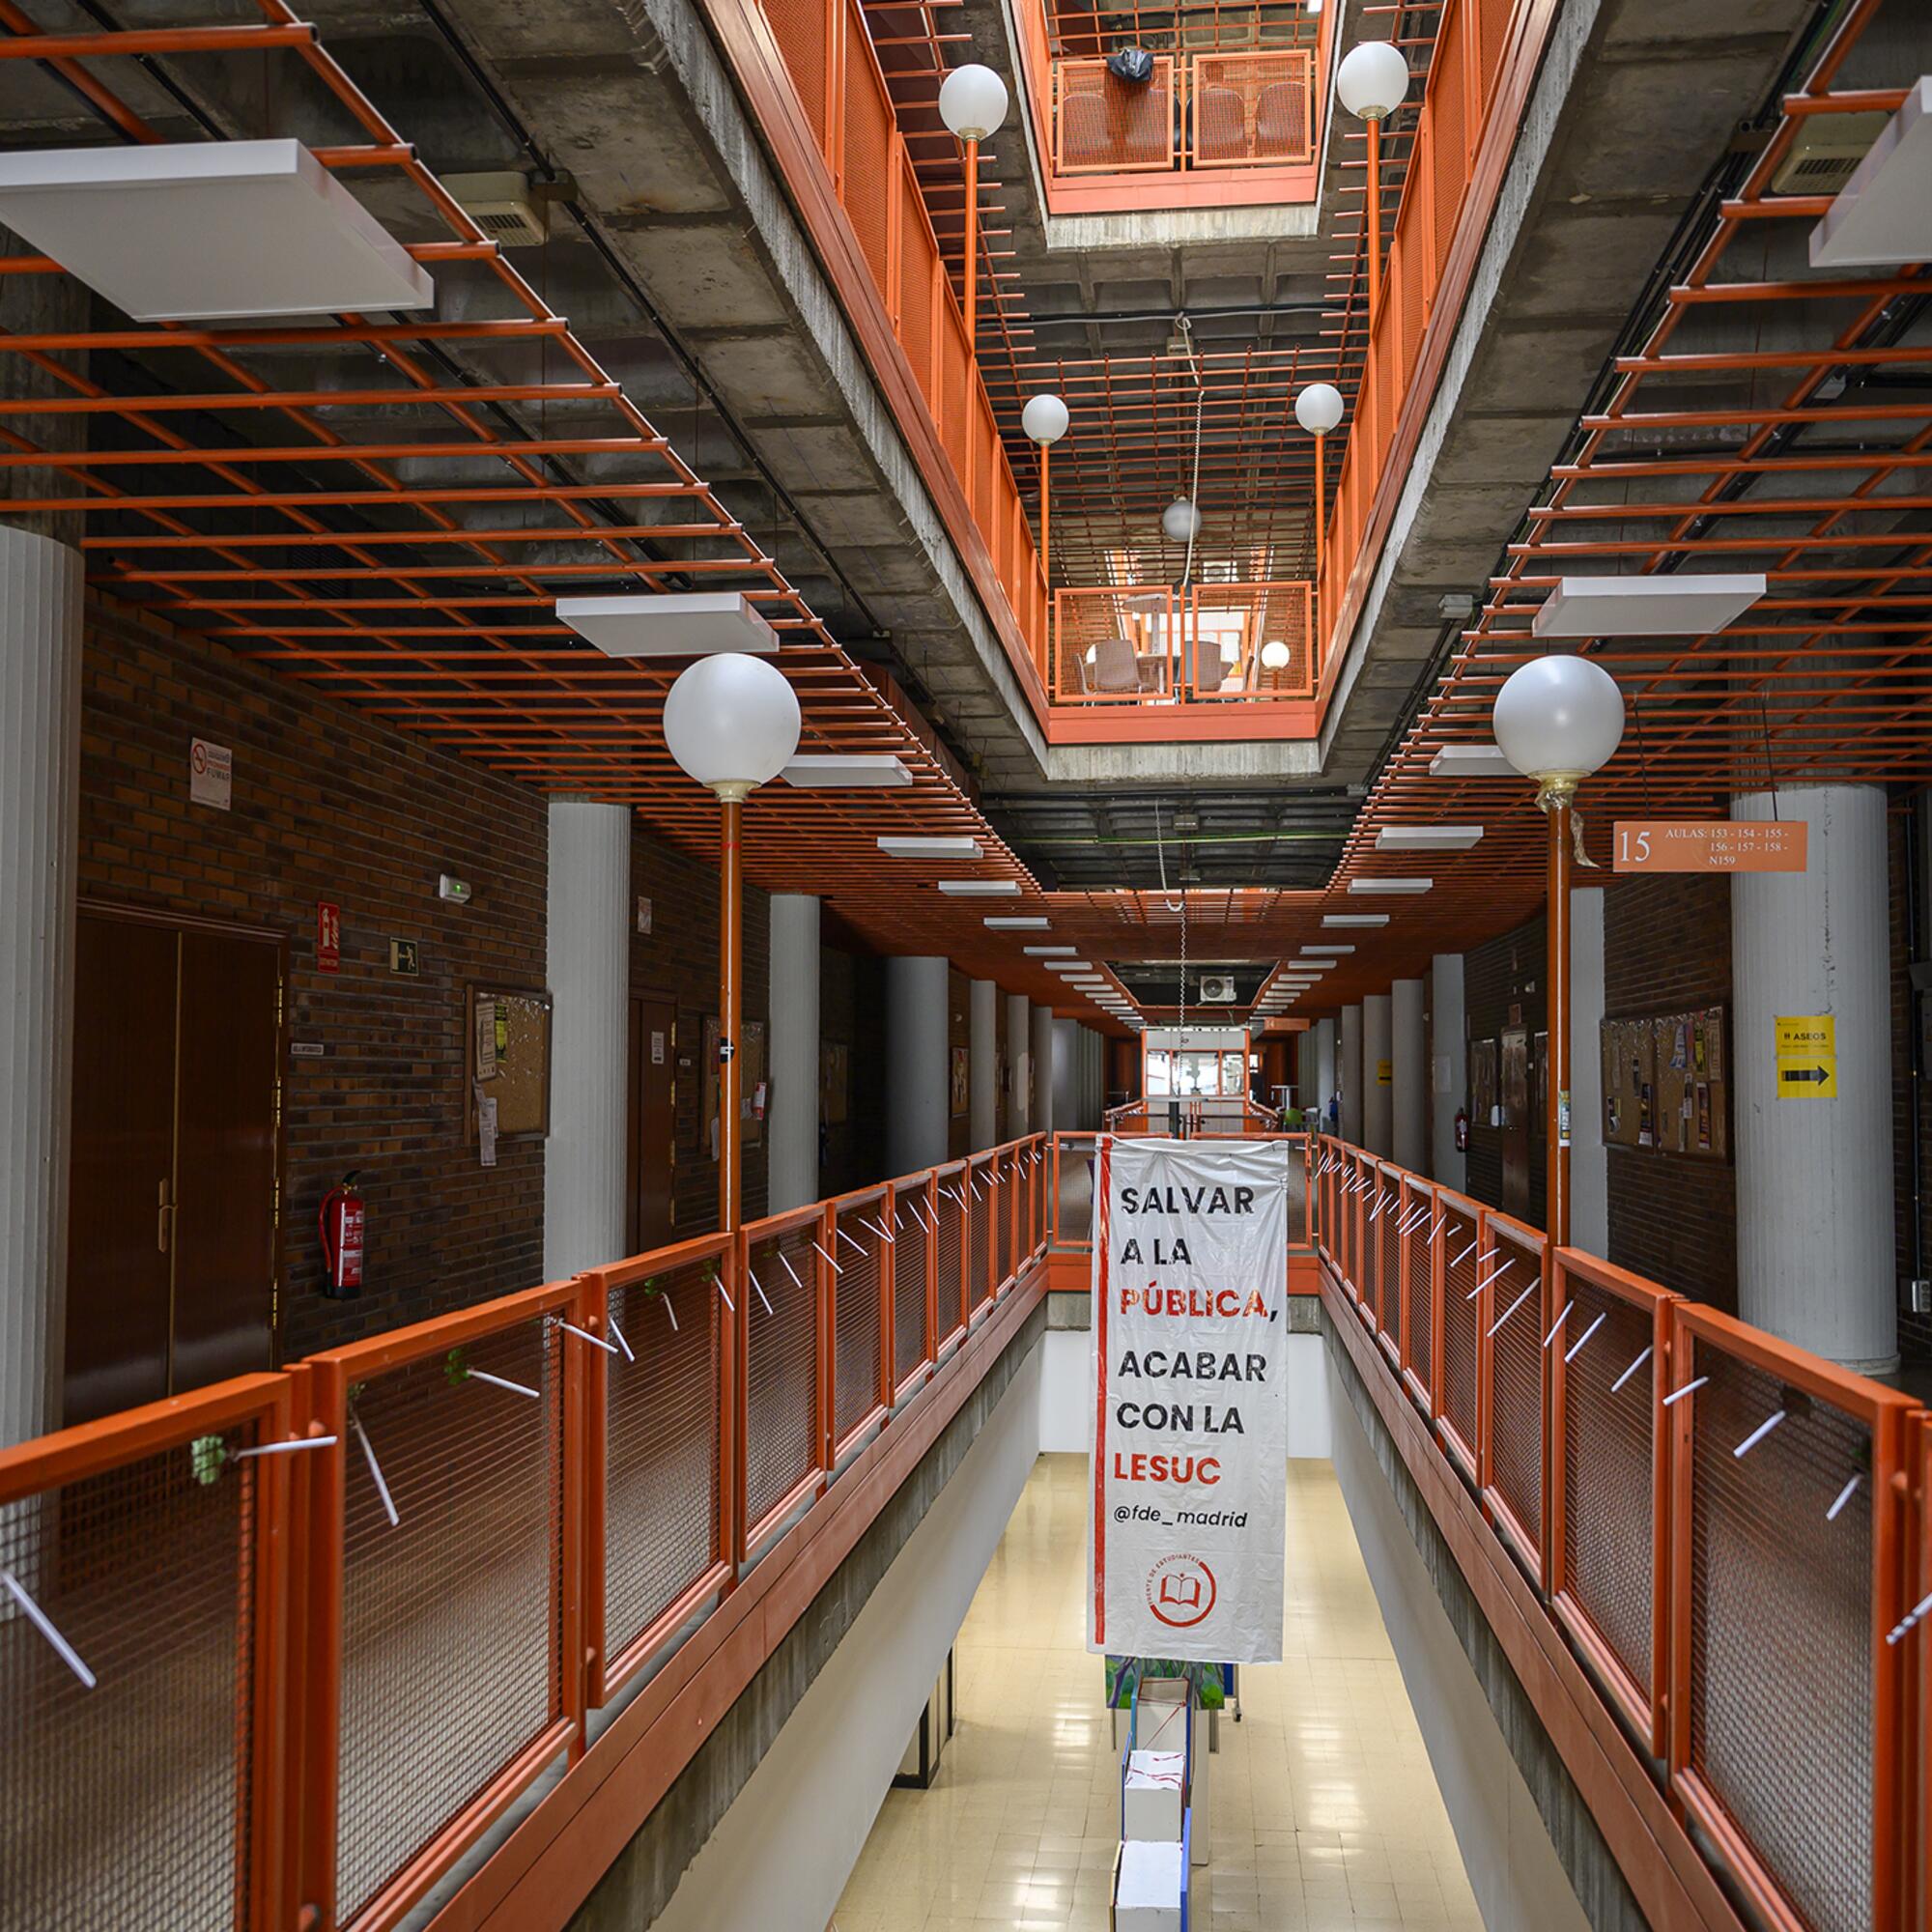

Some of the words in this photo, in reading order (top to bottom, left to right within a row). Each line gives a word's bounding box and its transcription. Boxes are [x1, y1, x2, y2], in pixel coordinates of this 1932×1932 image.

[1620, 831, 1652, 862] 15
[1665, 829, 1708, 838] AULAS:
[1711, 829, 1727, 838] 153
[1738, 829, 1754, 838] 154
[1765, 829, 1781, 838] 155
[1710, 842, 1727, 852] 156
[1737, 842, 1754, 852] 157
[1764, 842, 1781, 852] 158
[1709, 856, 1735, 866] N159
[1793, 1032, 1826, 1040] ASEOS
[1121, 1186, 1255, 1214] SALVAR
[1121, 1238, 1144, 1264] A
[1154, 1238, 1191, 1265] LA
[1121, 1281, 1278, 1322] PÚBLICA,
[1119, 1350, 1266, 1381] ACABAR
[1117, 1402, 1194, 1432] CON
[1204, 1405, 1245, 1435] LA
[1114, 1453, 1221, 1484] LESUC
